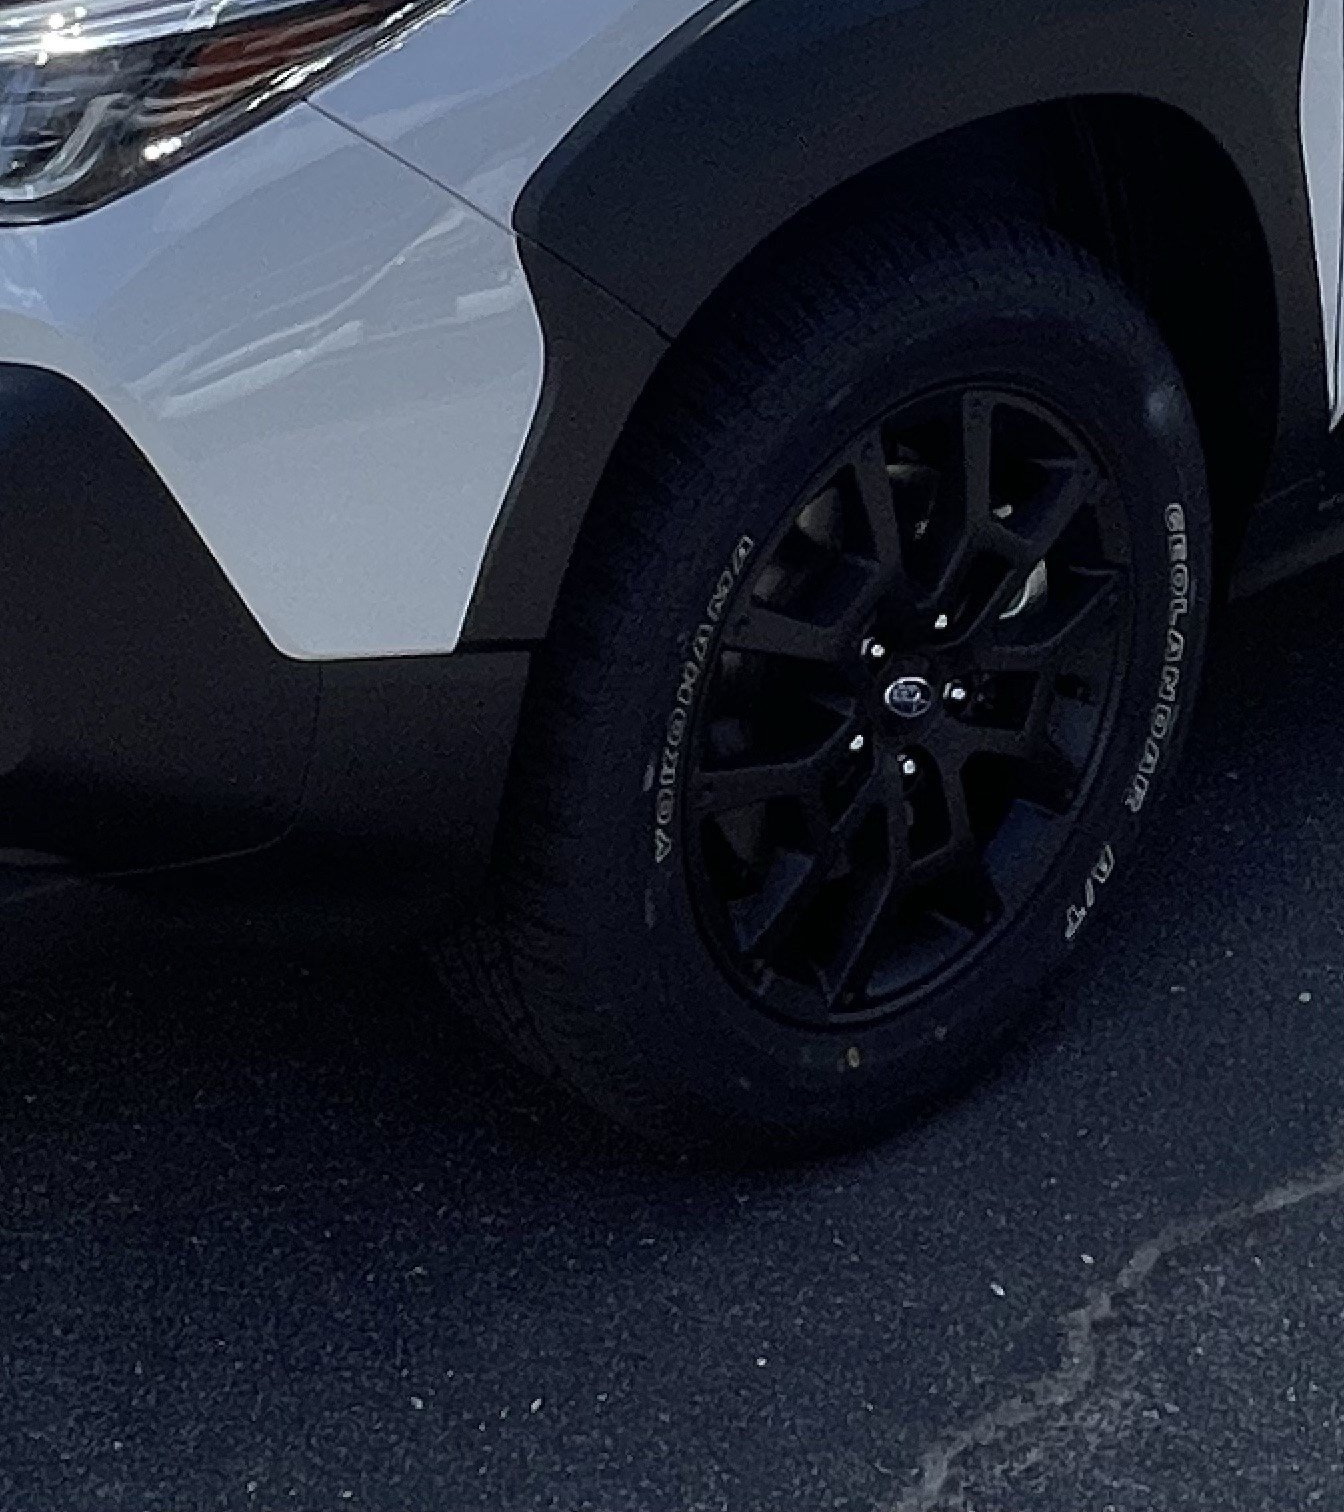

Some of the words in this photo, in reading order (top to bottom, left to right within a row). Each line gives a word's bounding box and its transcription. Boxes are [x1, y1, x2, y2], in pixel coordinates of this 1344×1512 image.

[654, 534, 756, 864] YOKOHAMA
[1124, 502, 1190, 813] GEOLANDAR
[1064, 841, 1116, 941] A/T
